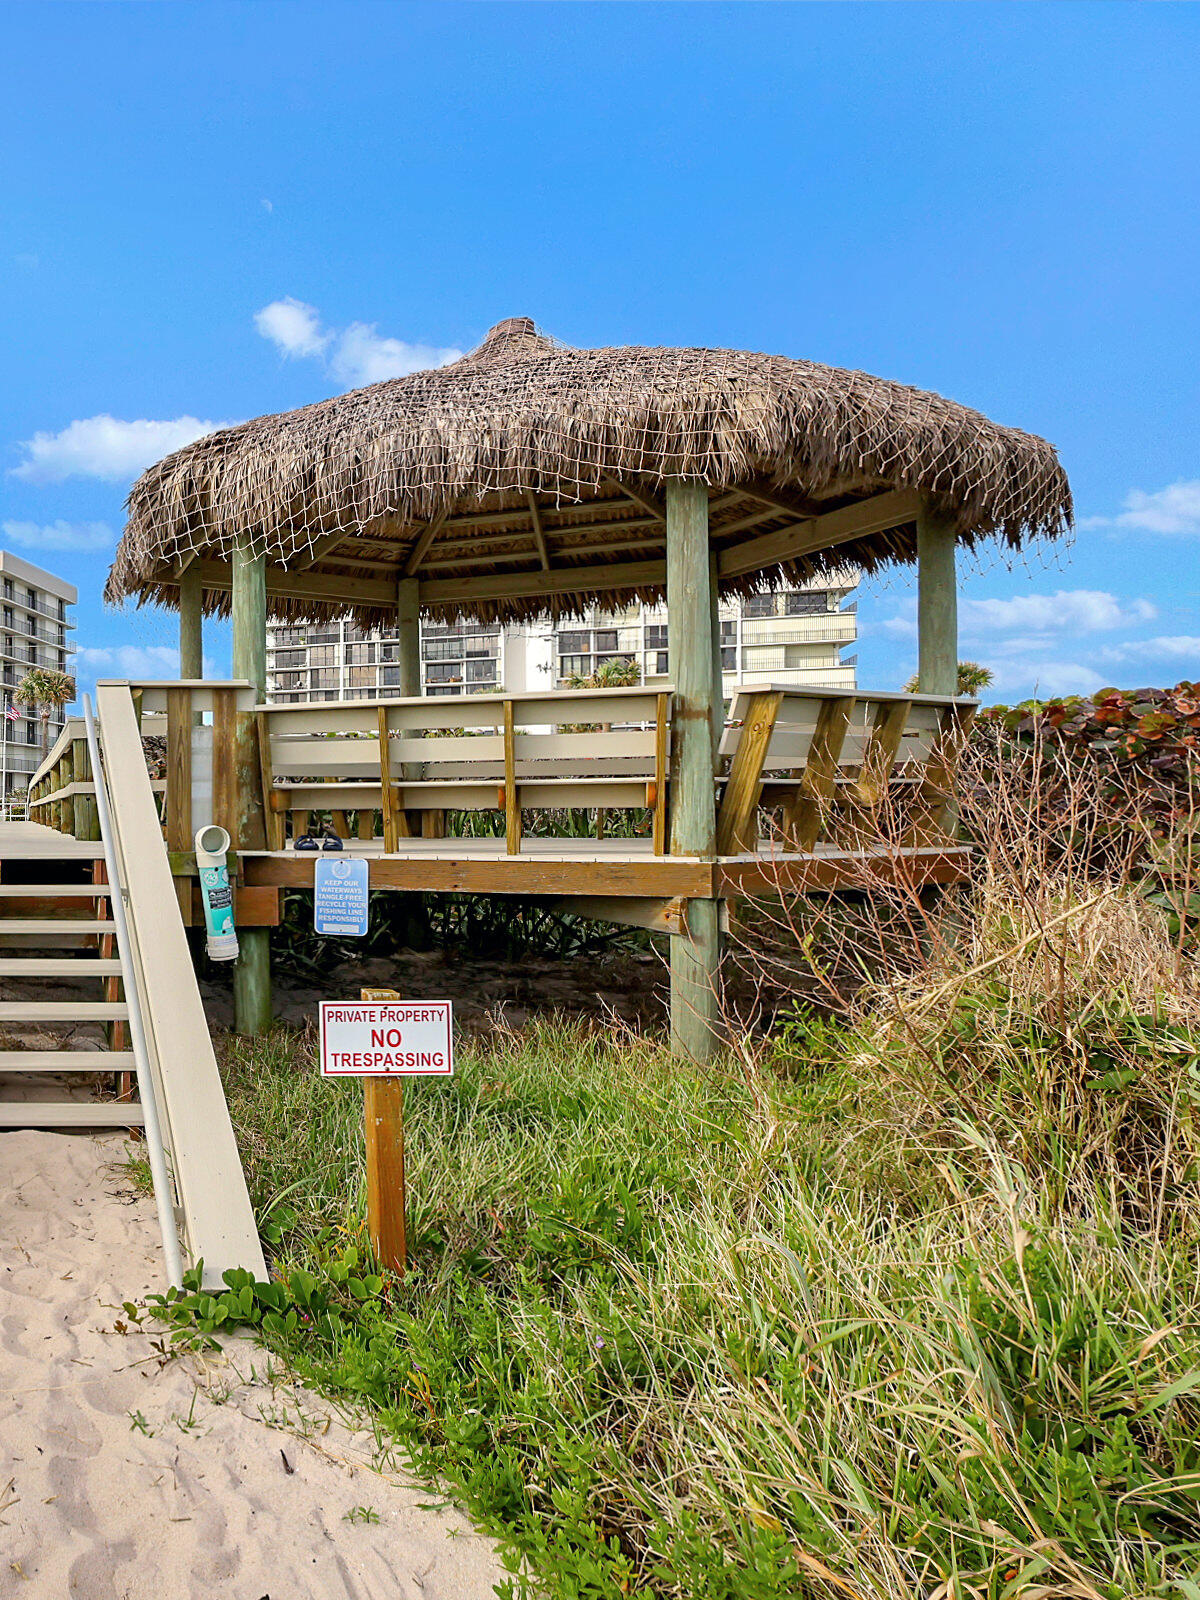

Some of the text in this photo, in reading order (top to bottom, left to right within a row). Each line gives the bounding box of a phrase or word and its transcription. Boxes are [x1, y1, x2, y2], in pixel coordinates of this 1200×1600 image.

[327, 1010, 444, 1022] PRIVATE PROPERTY
[371, 1029, 402, 1048] NO
[331, 1052, 444, 1067] TRESPASSING
